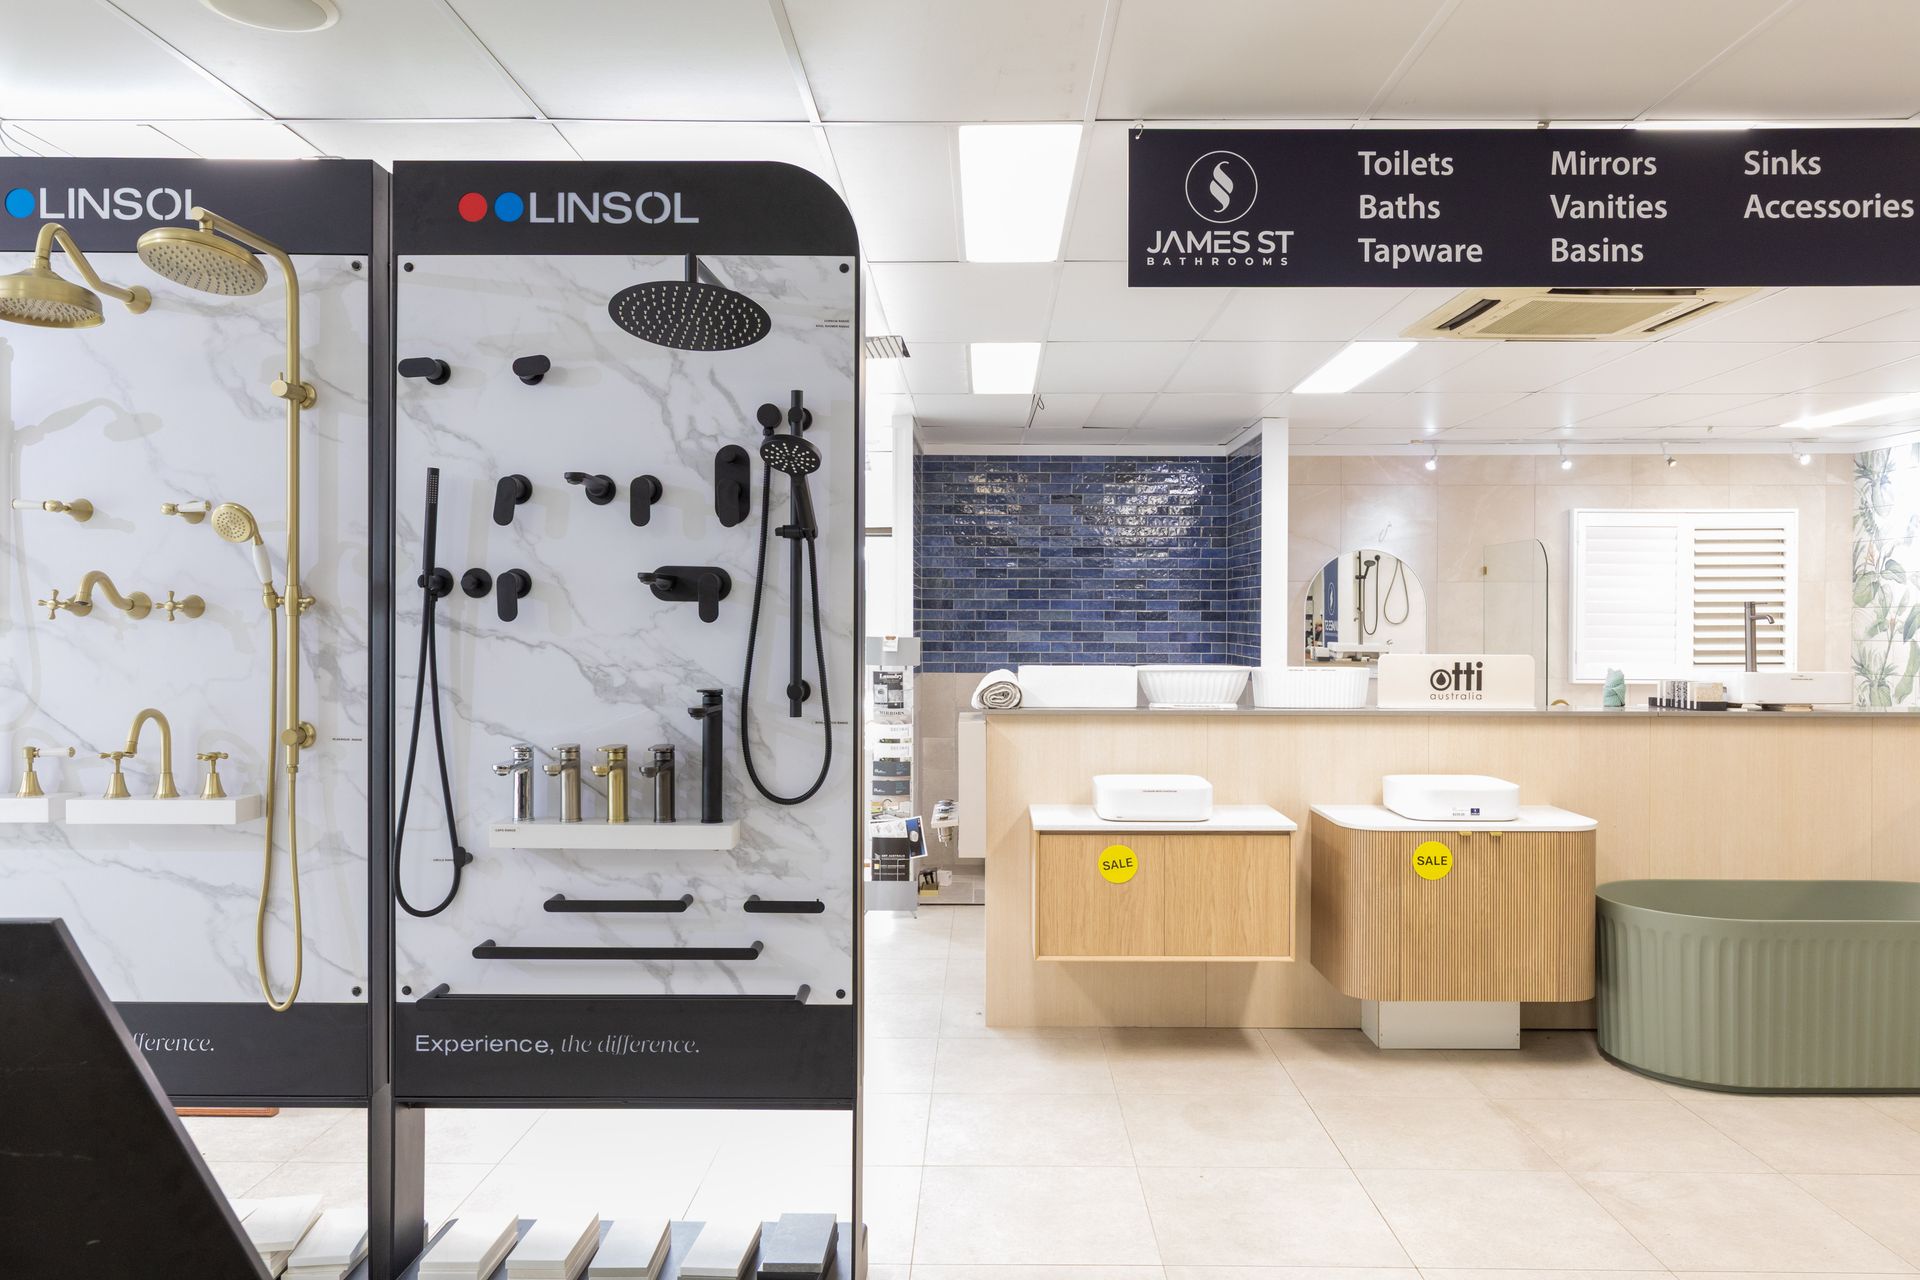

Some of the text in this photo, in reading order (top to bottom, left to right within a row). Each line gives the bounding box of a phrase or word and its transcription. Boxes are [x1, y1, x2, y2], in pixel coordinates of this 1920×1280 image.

[1358, 150, 1454, 176] Toilets
[1551, 150, 1657, 176] Mirrors
[1744, 150, 1822, 176] Sinks
[39, 187, 194, 221] LINSOL
[529, 191, 700, 224] LINSOL
[1359, 193, 1441, 219] Baths
[1549, 193, 1668, 219] Vanities
[1743, 193, 1915, 219] Accessories
[1146, 230, 1295, 254] JAMES ST
[1358, 238, 1483, 269] Tapware
[1551, 237, 1644, 263] Basins
[1146, 257, 1289, 266] BATHROOMS
[1430, 661, 1483, 691] otti
[1430, 692, 1483, 701] australia
[1102, 857, 1134, 871] SALE
[1417, 855, 1448, 866] SALE
[415, 1034, 700, 1056] Experience, the difference.
